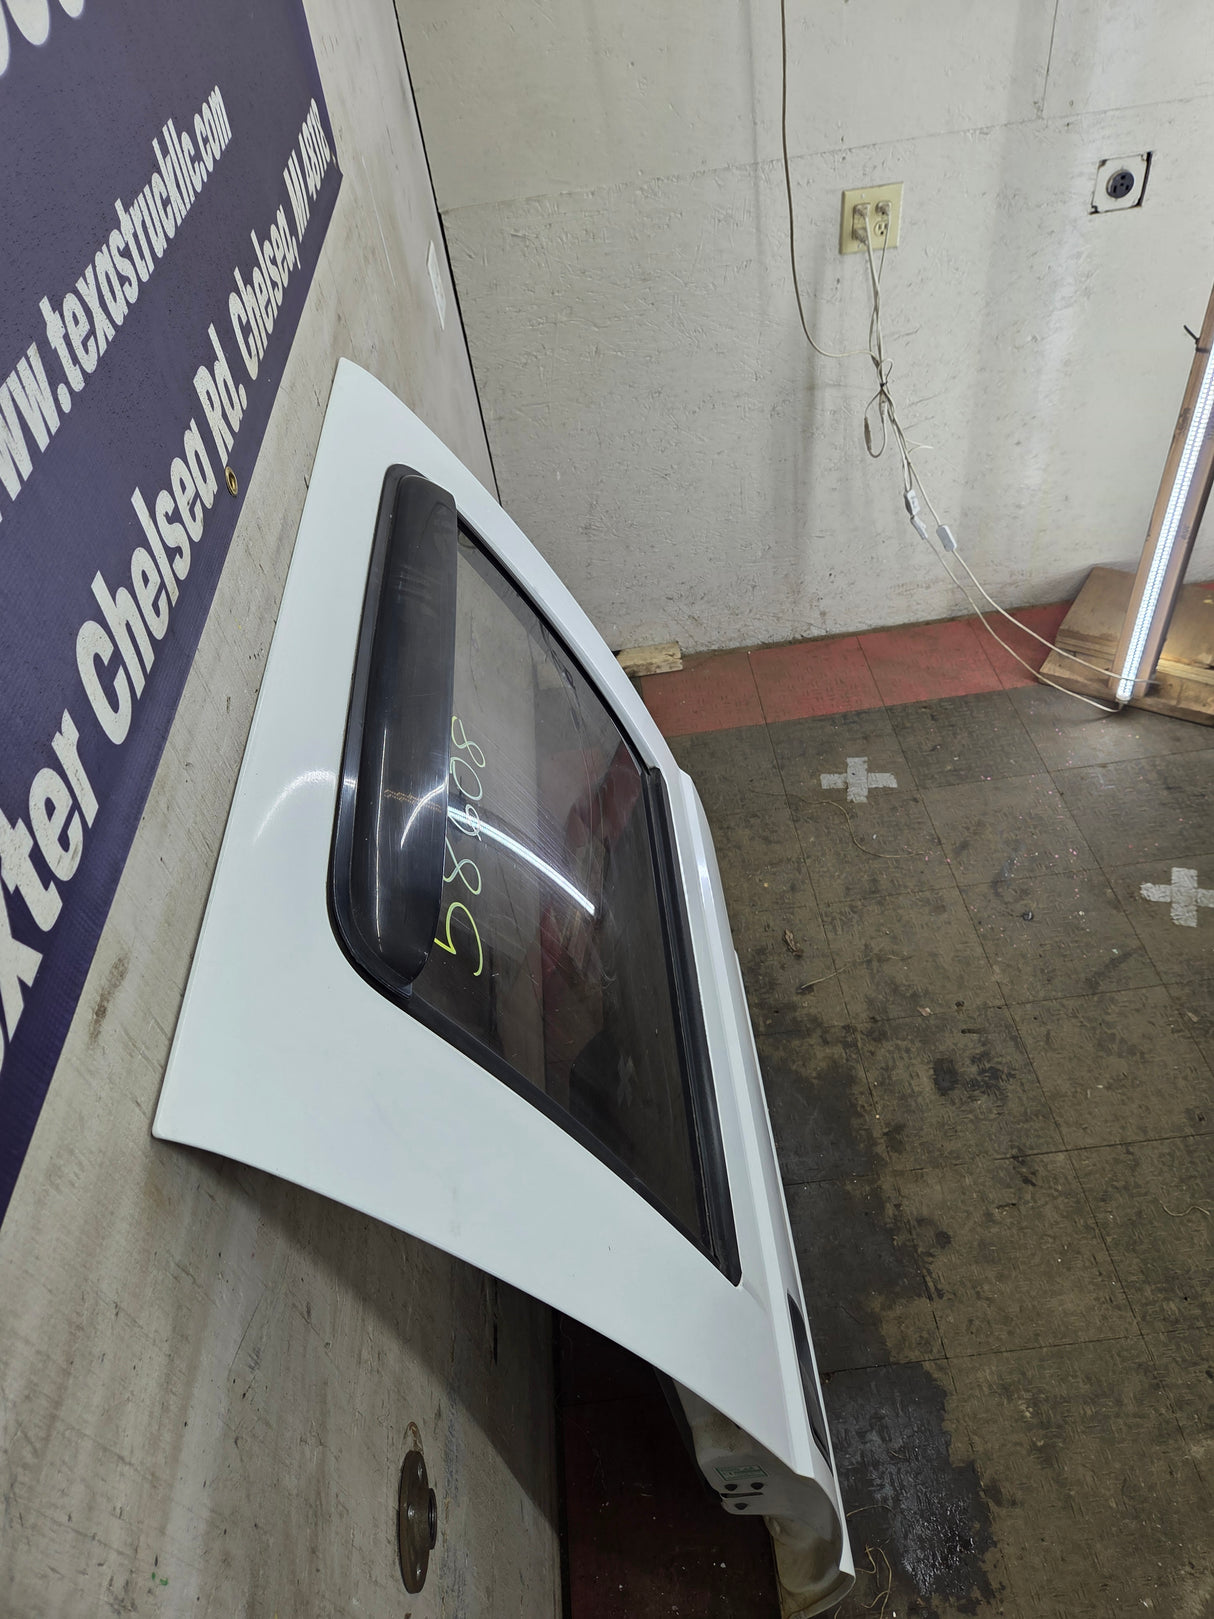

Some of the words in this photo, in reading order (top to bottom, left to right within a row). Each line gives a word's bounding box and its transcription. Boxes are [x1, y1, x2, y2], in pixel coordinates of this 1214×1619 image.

[0, 85, 232, 521] ww.texastruckllc.com
[76, 417, 218, 745] Chelsea
[193, 323, 248, 467] Rd.
[229, 204, 302, 381] Chelsea,
[283, 149, 311, 244] MI
[299, 98, 331, 201] 48118
